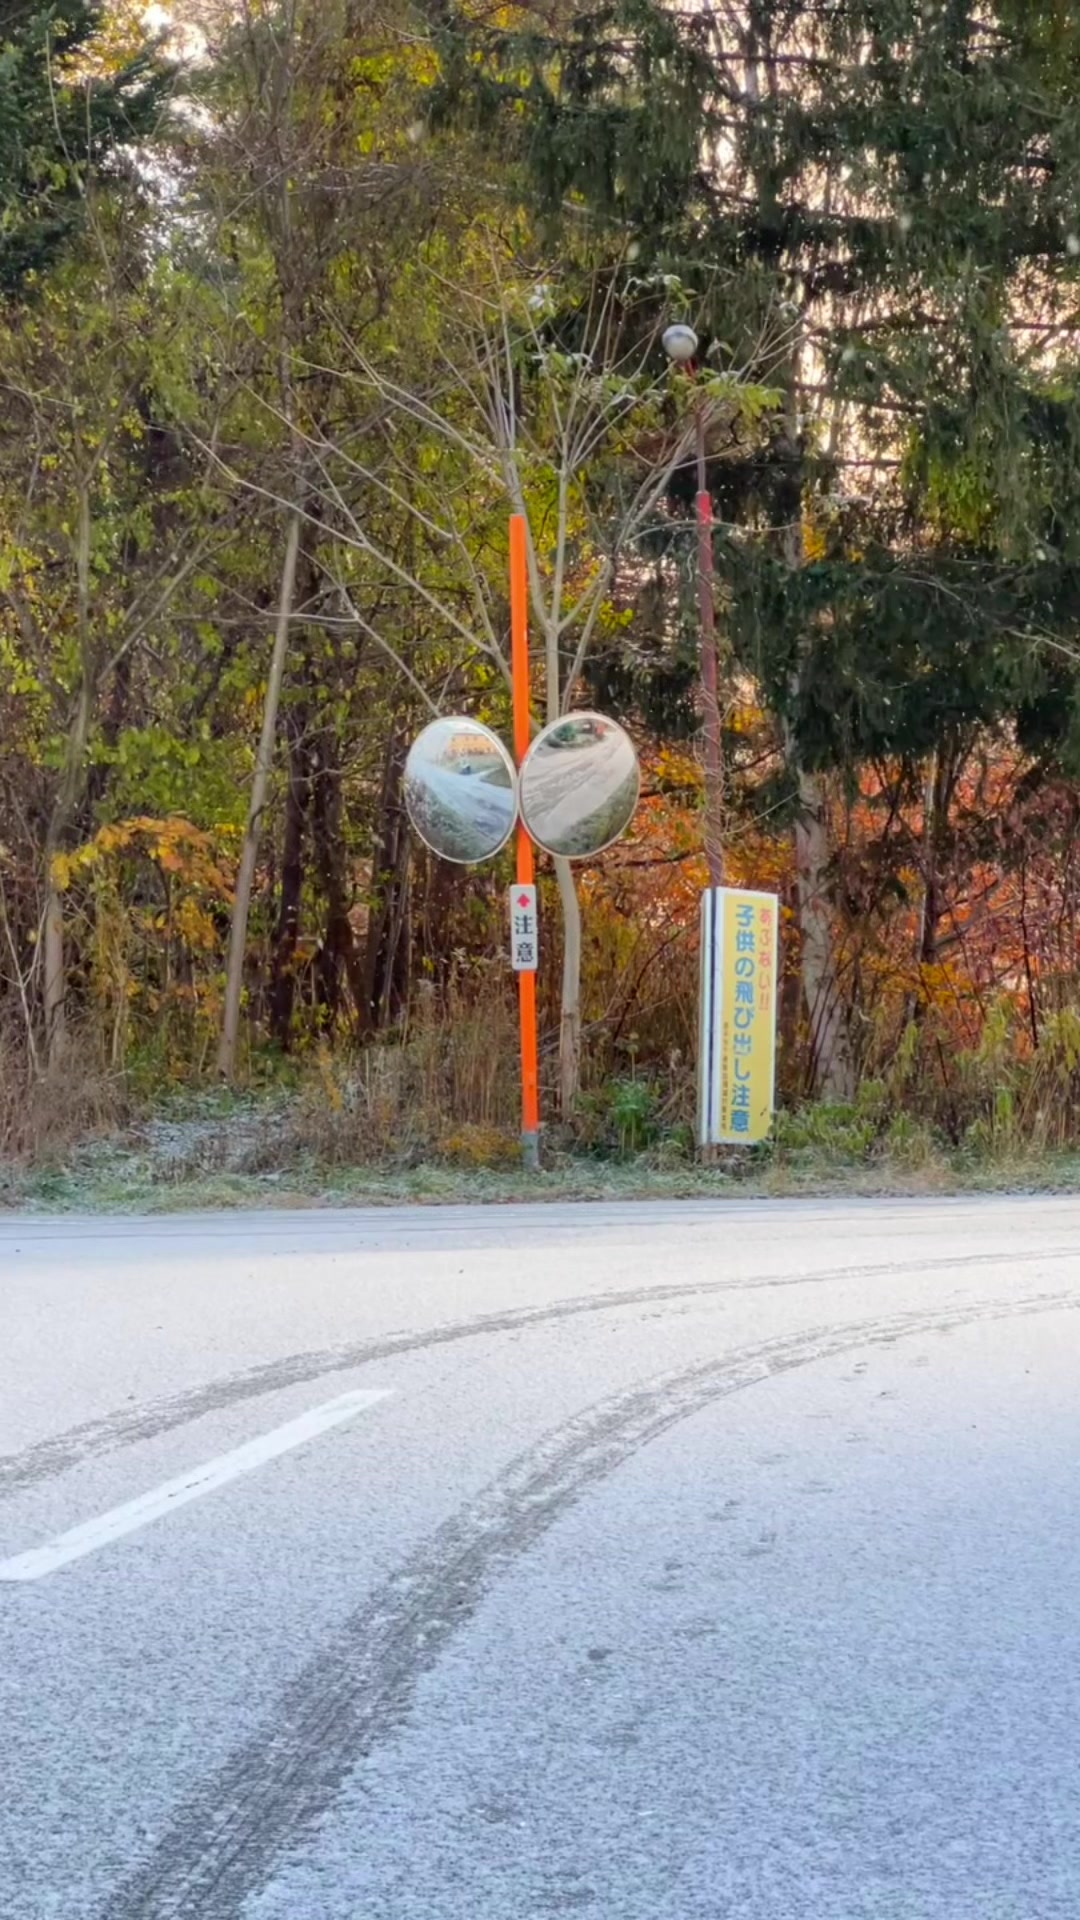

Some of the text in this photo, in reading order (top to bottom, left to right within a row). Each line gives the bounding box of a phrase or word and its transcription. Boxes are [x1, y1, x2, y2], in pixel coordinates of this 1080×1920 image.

[514, 915, 534, 962] 注意
[730, 904, 755, 1132] 子供の飛び出し注意
